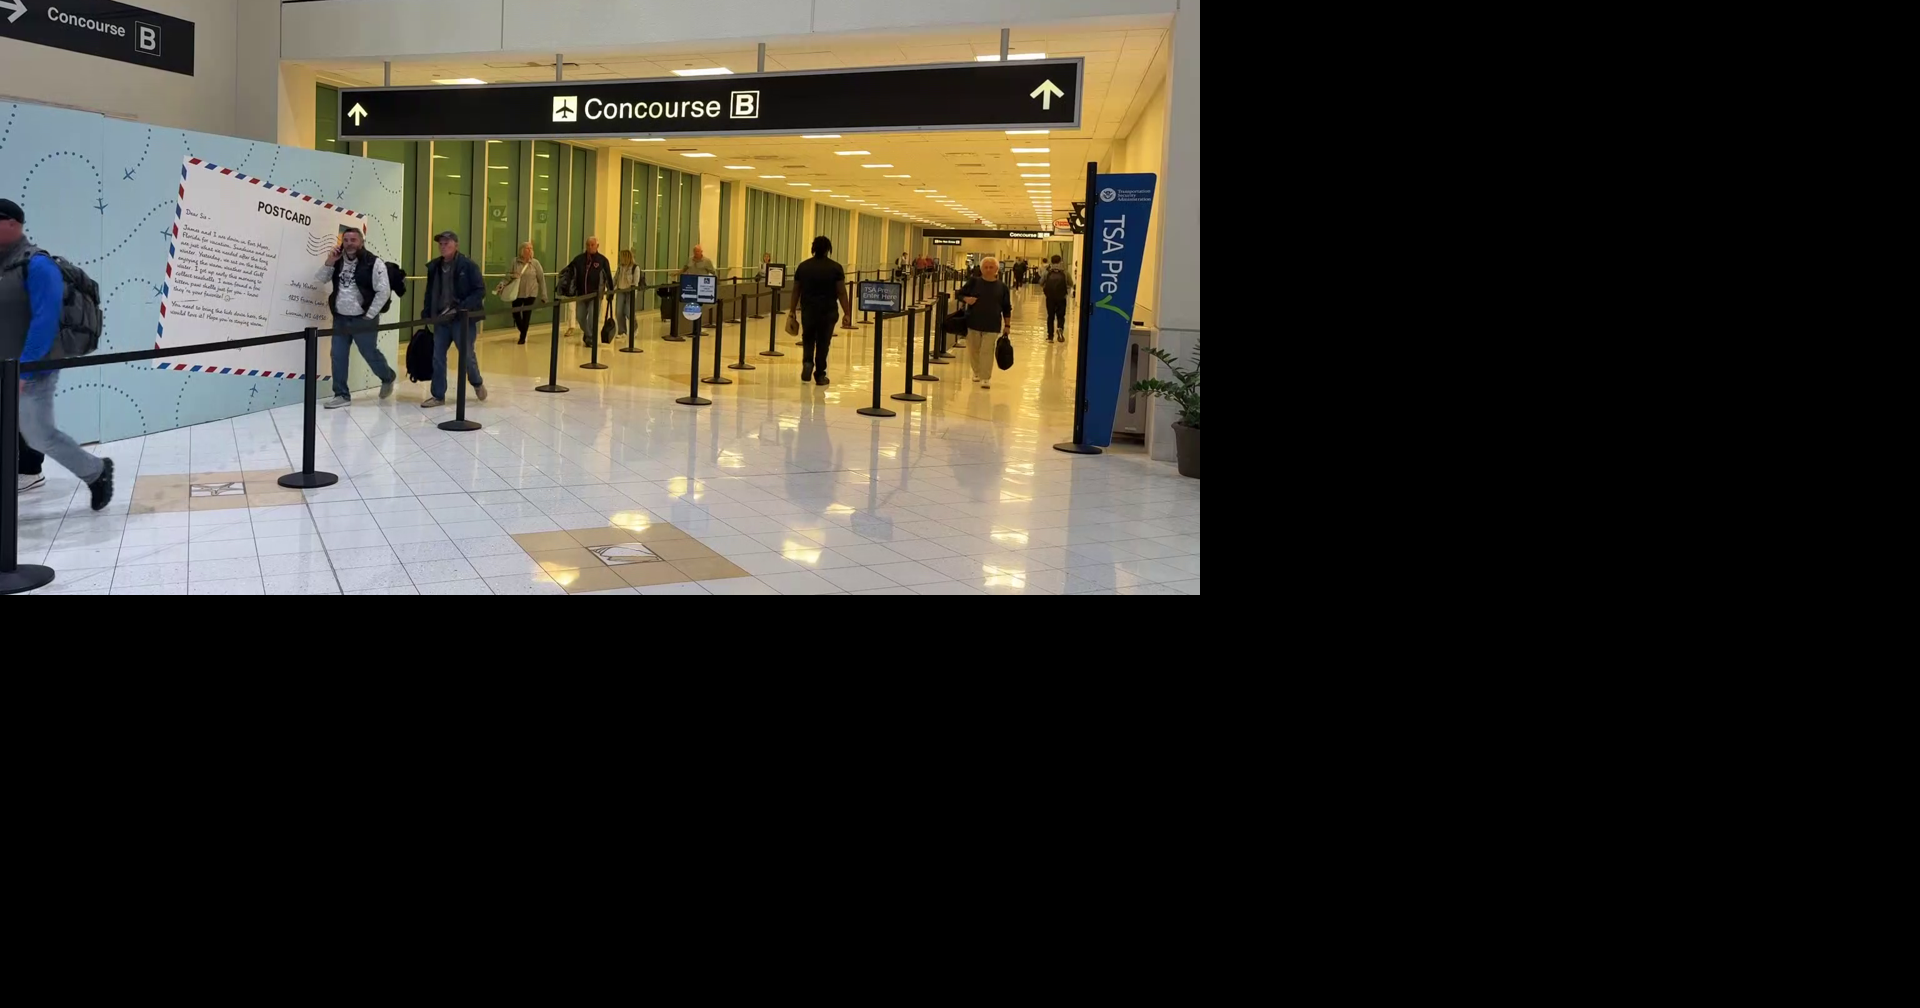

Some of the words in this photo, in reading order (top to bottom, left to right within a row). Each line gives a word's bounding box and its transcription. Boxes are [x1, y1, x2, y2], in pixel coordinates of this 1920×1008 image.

[48, 7, 125, 37] Concourse
[140, 26, 156, 51] B
[585, 98, 720, 120] Concourse
[735, 94, 755, 116] B
[186, 209, 198, 217] Dear
[257, 201, 312, 226] POSTCARD
[183, 225, 199, 233] James
[183, 232, 200, 241] Florida
[1102, 214, 1126, 254] TSA
[178, 257, 198, 265] enjoying
[1100, 260, 1123, 294] Pre
[175, 278, 189, 286] kitten
[202, 305, 214, 314] bring
